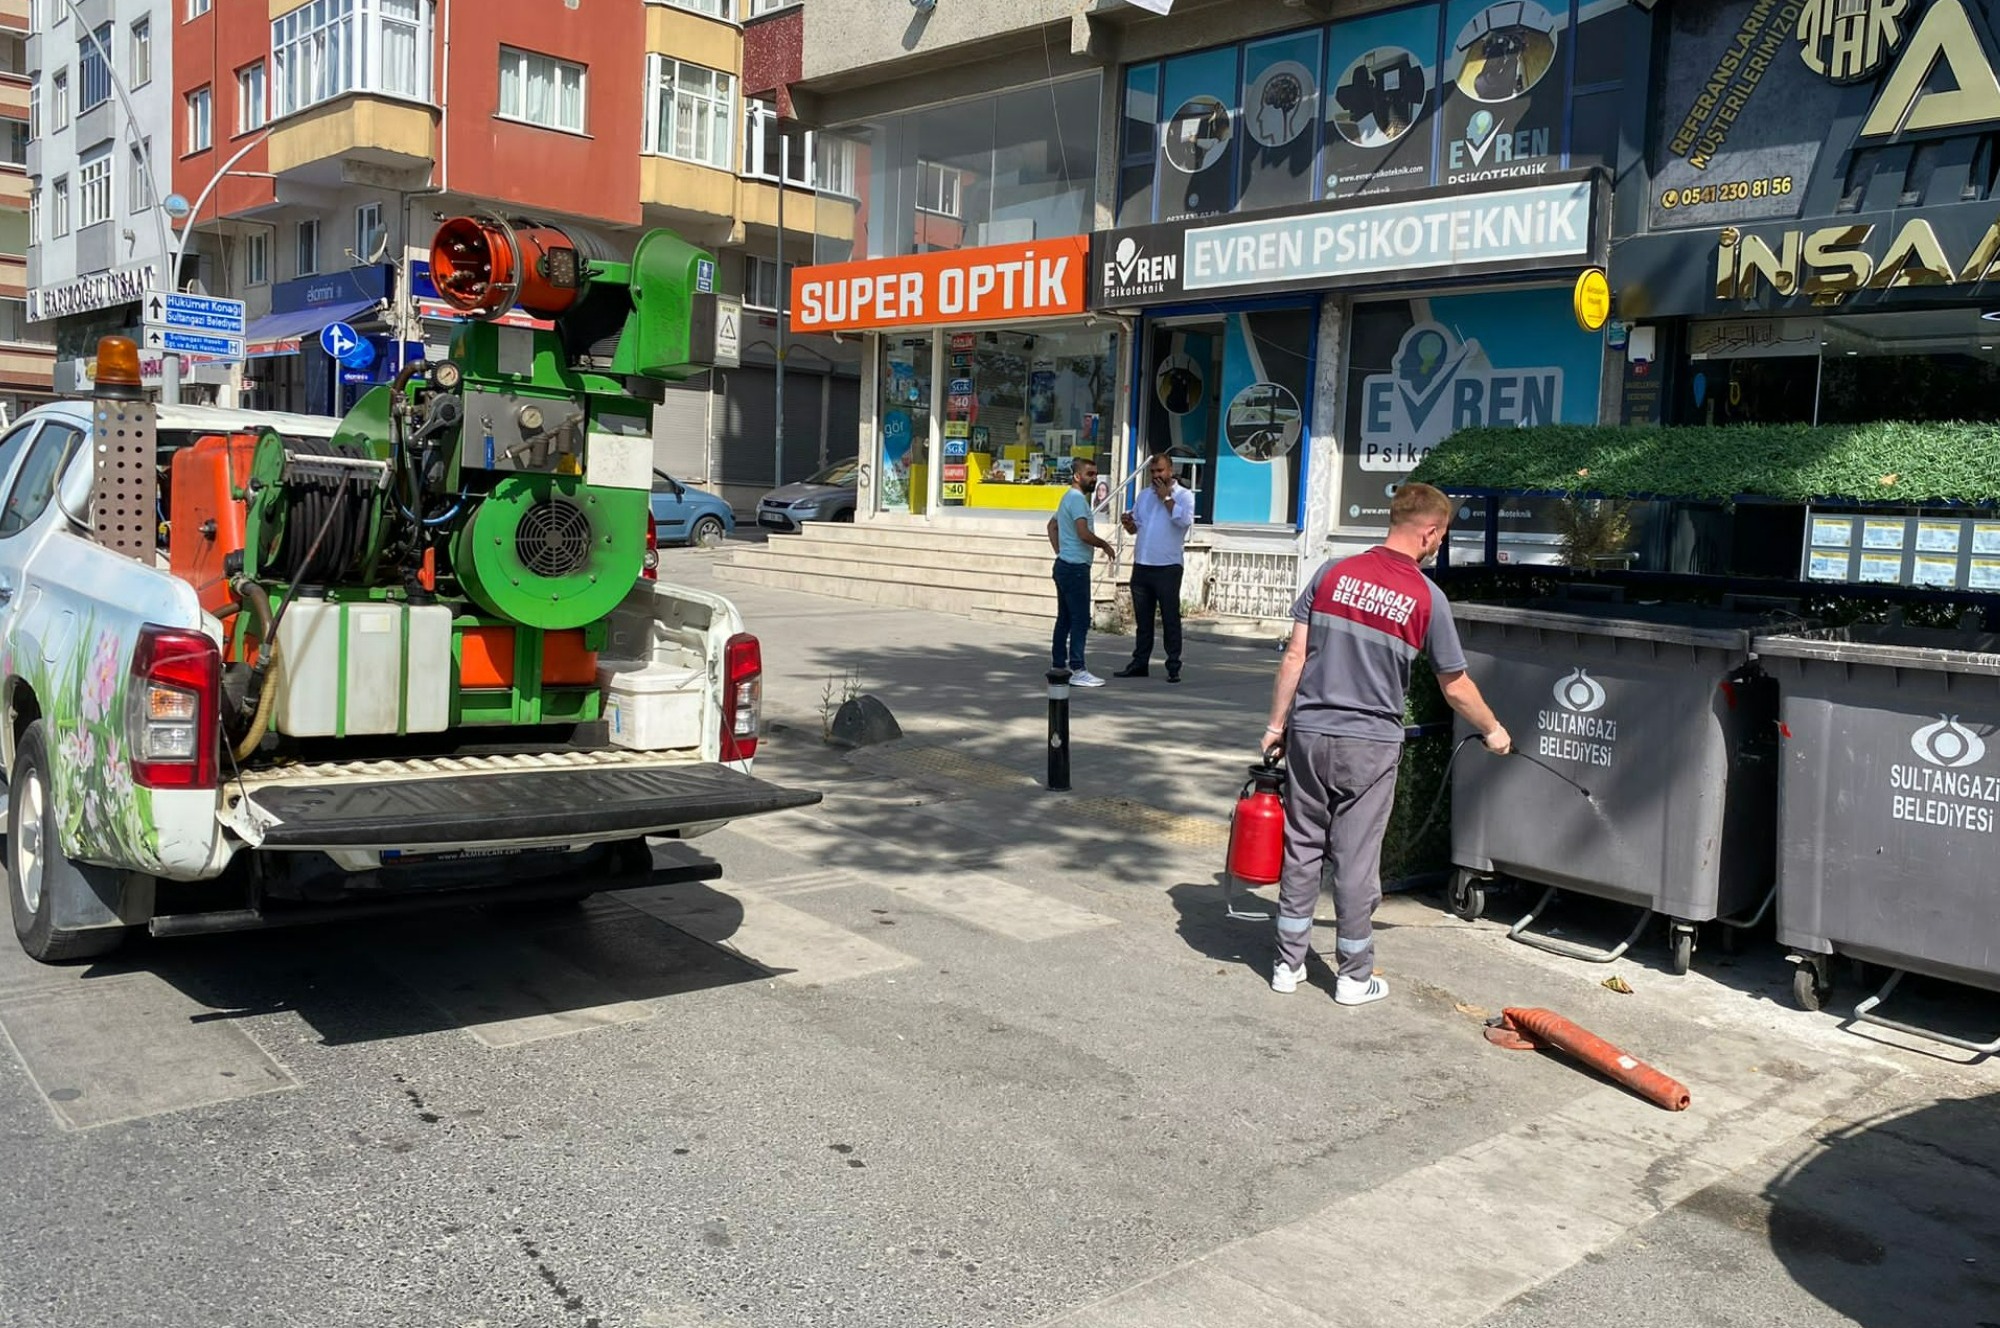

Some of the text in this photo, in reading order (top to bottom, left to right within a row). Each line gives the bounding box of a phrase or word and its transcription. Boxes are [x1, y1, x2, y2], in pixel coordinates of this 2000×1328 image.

[1449, 117, 1549, 169] EVREN
[1681, 177, 1792, 206] 0541 230 81 56
[1104, 245, 1176, 286] EVREN
[1194, 230, 1302, 278] EVREN
[801, 251, 1069, 324] SUPER OPTİK
[1104, 282, 1164, 298] Psikoteknik
[168, 296, 241, 315] Hükümet Konağı
[168, 311, 240, 329] Sultangazi Belediyesi
[1367, 350, 1555, 434] EVREN
[884, 420, 904, 438] gör
[946, 445, 964, 454] SGK
